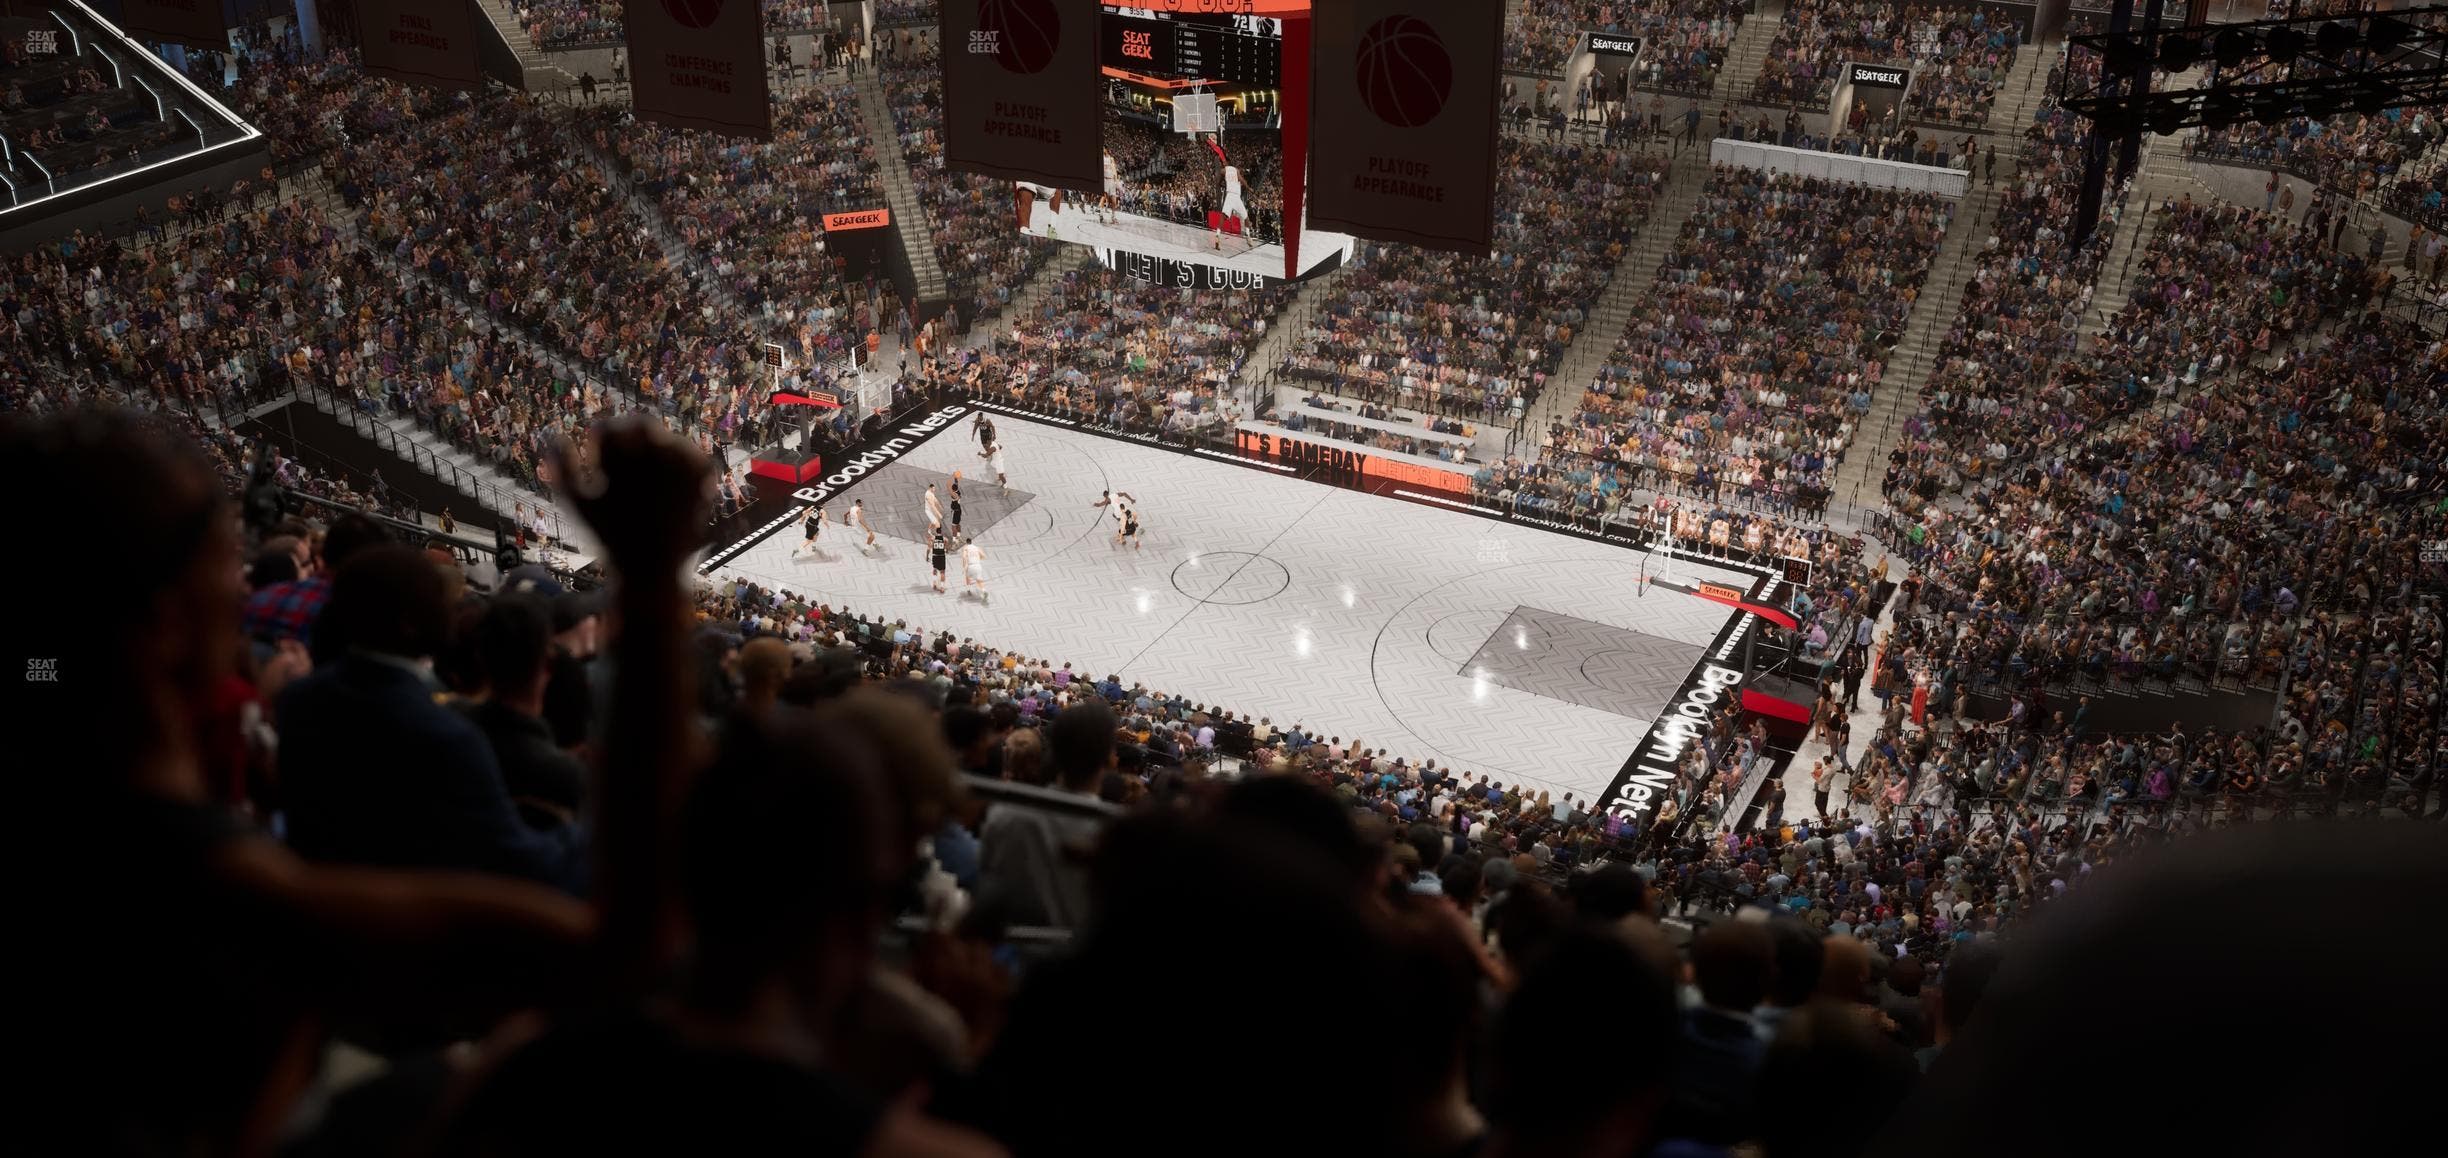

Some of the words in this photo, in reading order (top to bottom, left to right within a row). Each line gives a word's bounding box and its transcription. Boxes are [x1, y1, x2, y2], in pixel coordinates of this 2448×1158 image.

[1232, 14, 1248, 29] 72
[1123, 30, 1151, 45] SEAT
[1592, 38, 1635, 53] SEATGEEK
[1121, 43, 1153, 60] GEEK
[665, 53, 733, 76] CONFERENCE
[670, 72, 731, 94] CHAMPIONS
[1855, 69, 1903, 85] SEATGEEK
[994, 102, 1048, 122] PLAYOFF
[984, 119, 1063, 144] APPEARANCE
[1369, 156, 1430, 178] PLAYOFF
[1354, 175, 1444, 202] APPEARANCE
[832, 214, 880, 227] SEATGEEK
[792, 437, 913, 502] Brooklyn
[899, 404, 967, 438] Nets
[1234, 428, 1271, 454] IT'S
[1279, 437, 1367, 472] GAMEDAY
[1374, 456, 1431, 485] LET'S
[1645, 663, 1744, 763] Brooklyn
